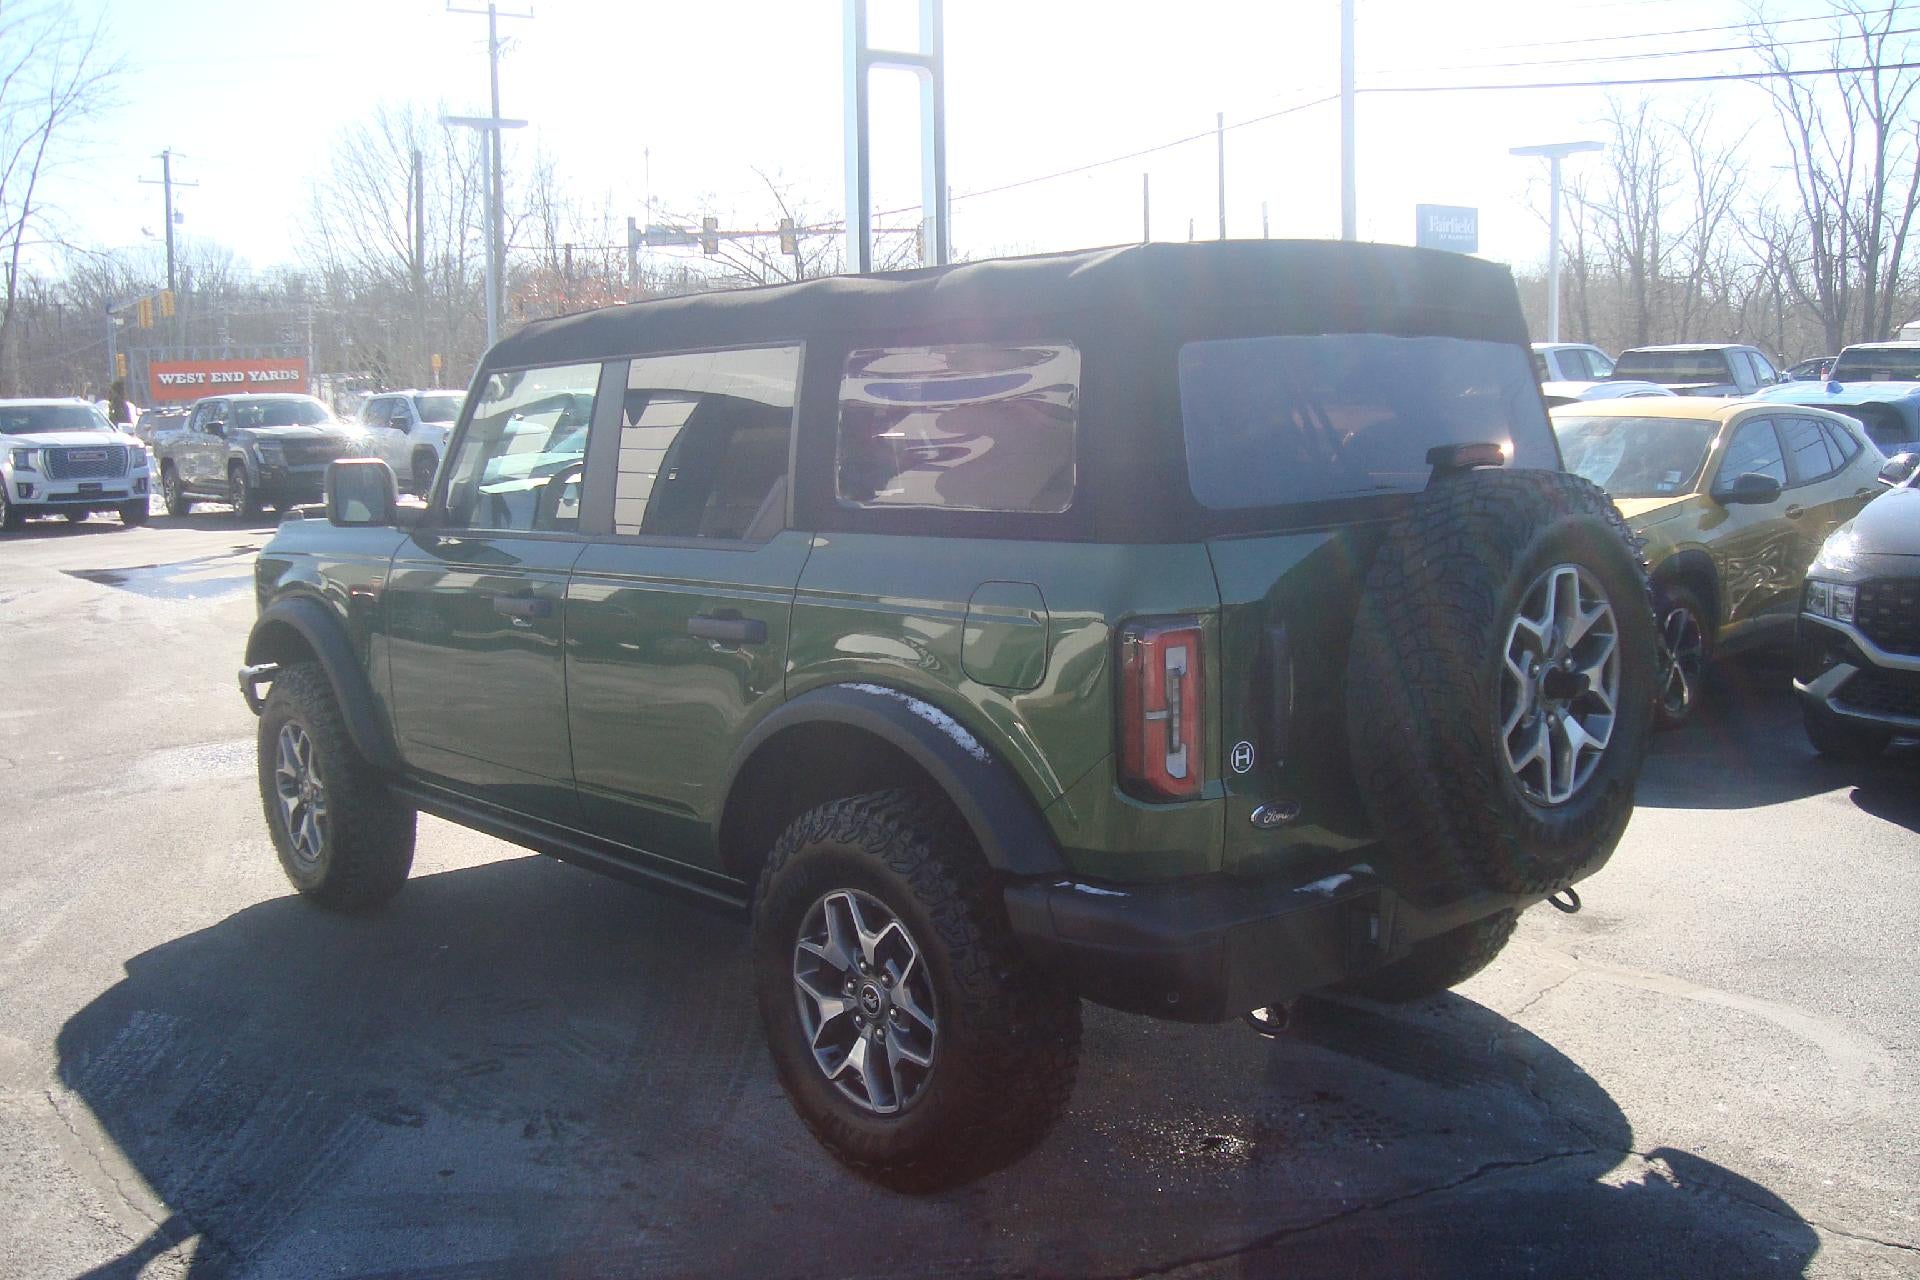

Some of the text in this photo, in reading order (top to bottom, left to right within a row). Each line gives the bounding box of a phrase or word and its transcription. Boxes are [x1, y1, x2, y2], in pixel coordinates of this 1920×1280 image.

[1429, 215, 1475, 234] Fairfield
[158, 370, 300, 384] WEST END YARDS
[1235, 748, 1250, 767] H
[1263, 808, 1291, 824] Ford
